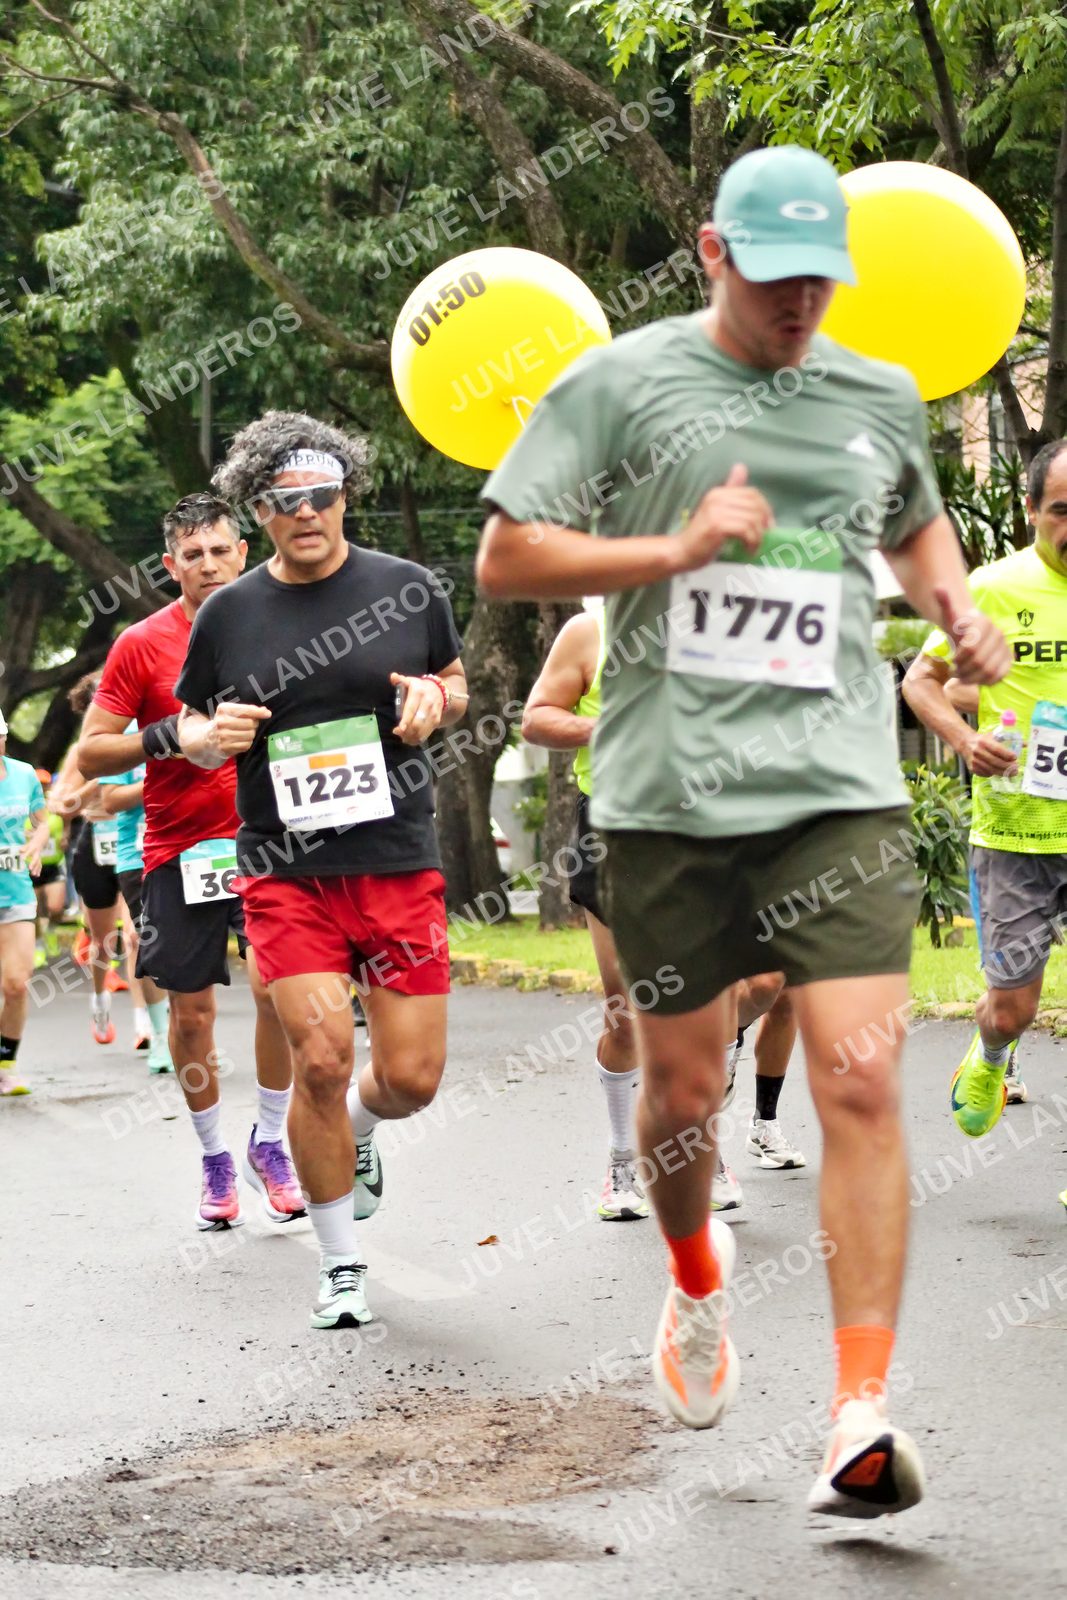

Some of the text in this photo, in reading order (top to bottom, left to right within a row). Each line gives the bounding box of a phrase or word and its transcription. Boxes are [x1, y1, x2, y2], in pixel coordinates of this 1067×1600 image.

[409, 271, 486, 347] 01:50
[689, 589, 825, 645] 1776
[284, 763, 379, 807] 1223
[200, 869, 238, 897] 36
